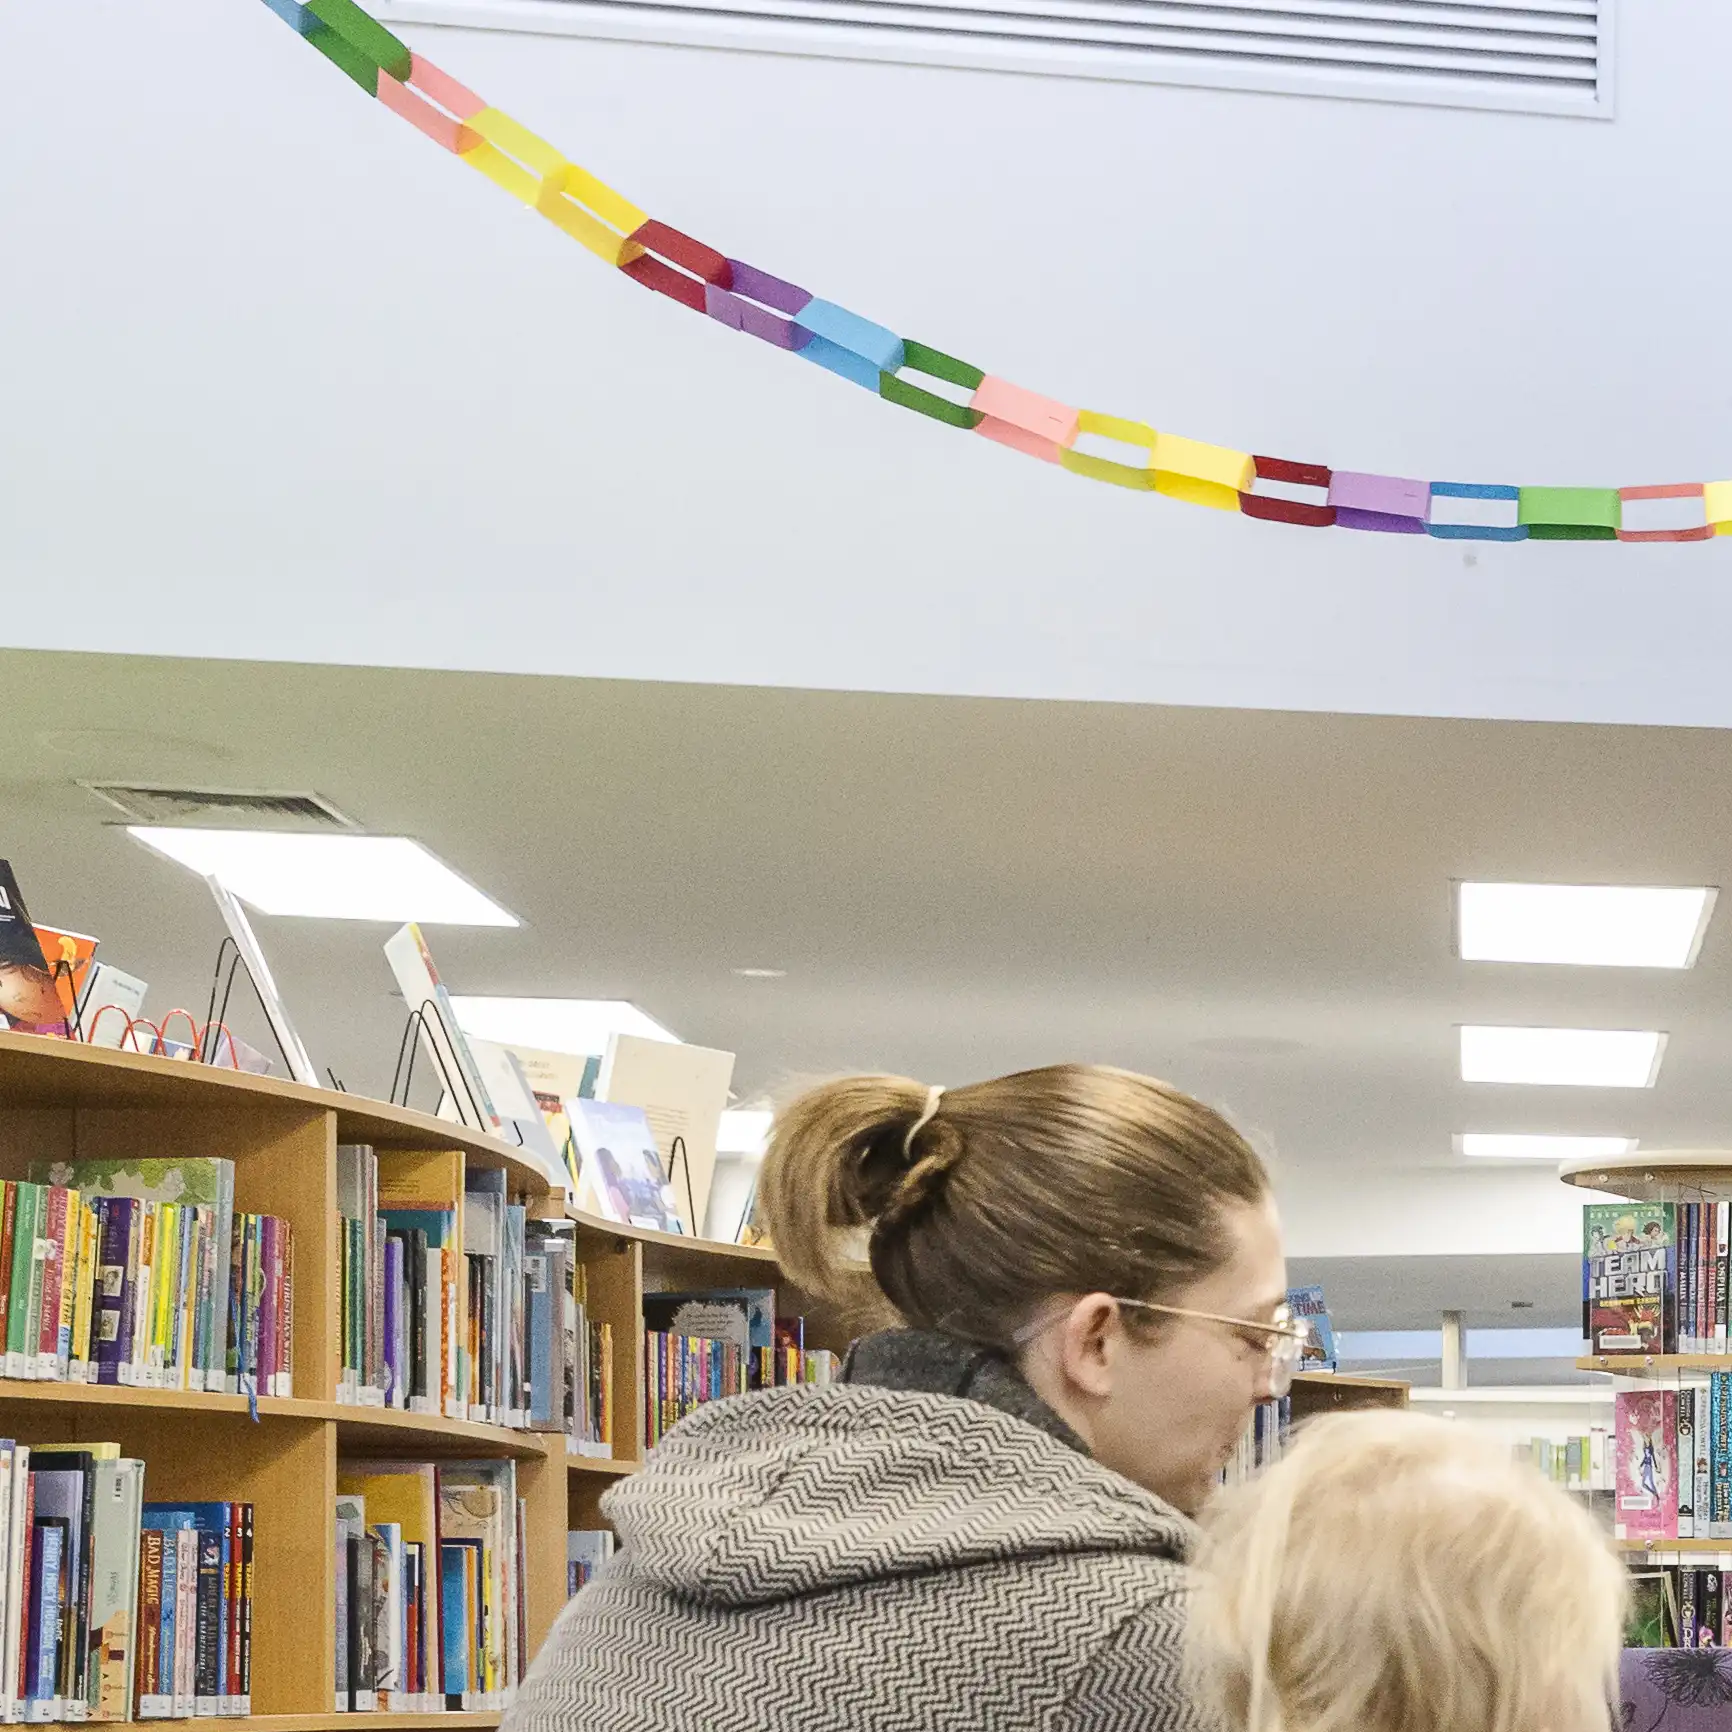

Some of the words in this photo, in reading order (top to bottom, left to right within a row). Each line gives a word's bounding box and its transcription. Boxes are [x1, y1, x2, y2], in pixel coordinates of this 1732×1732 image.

[1590, 1248, 1667, 1278] TEAM
[1589, 1270, 1669, 1299] HERO
[1716, 1261, 1726, 1302] OSPIRA
[147, 1535, 162, 1564] BAD
[146, 1567, 160, 1605] MAGIC
